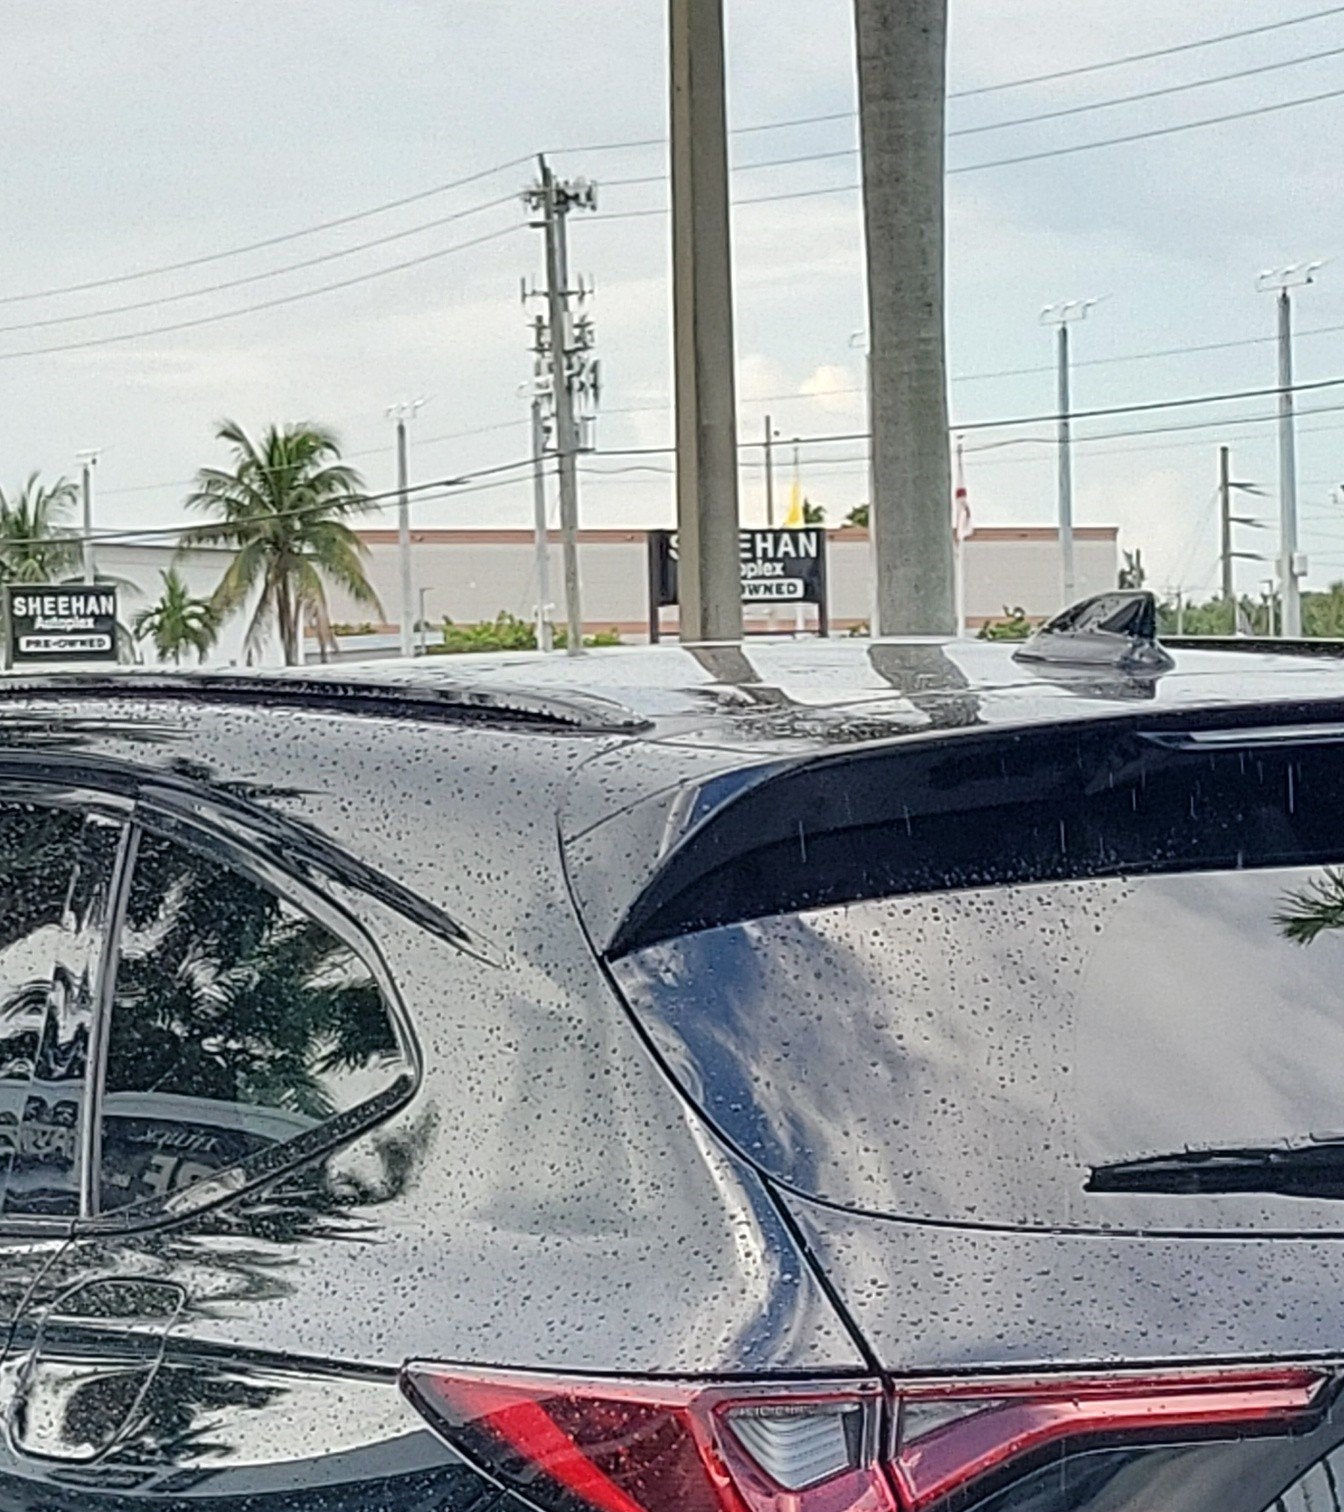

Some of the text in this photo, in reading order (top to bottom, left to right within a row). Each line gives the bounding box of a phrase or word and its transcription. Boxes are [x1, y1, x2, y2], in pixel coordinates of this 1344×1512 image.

[13, 594, 114, 616] SHEEHAN
[34, 615, 95, 632] Autoplex
[25, 637, 106, 649] PRE-OWNED
